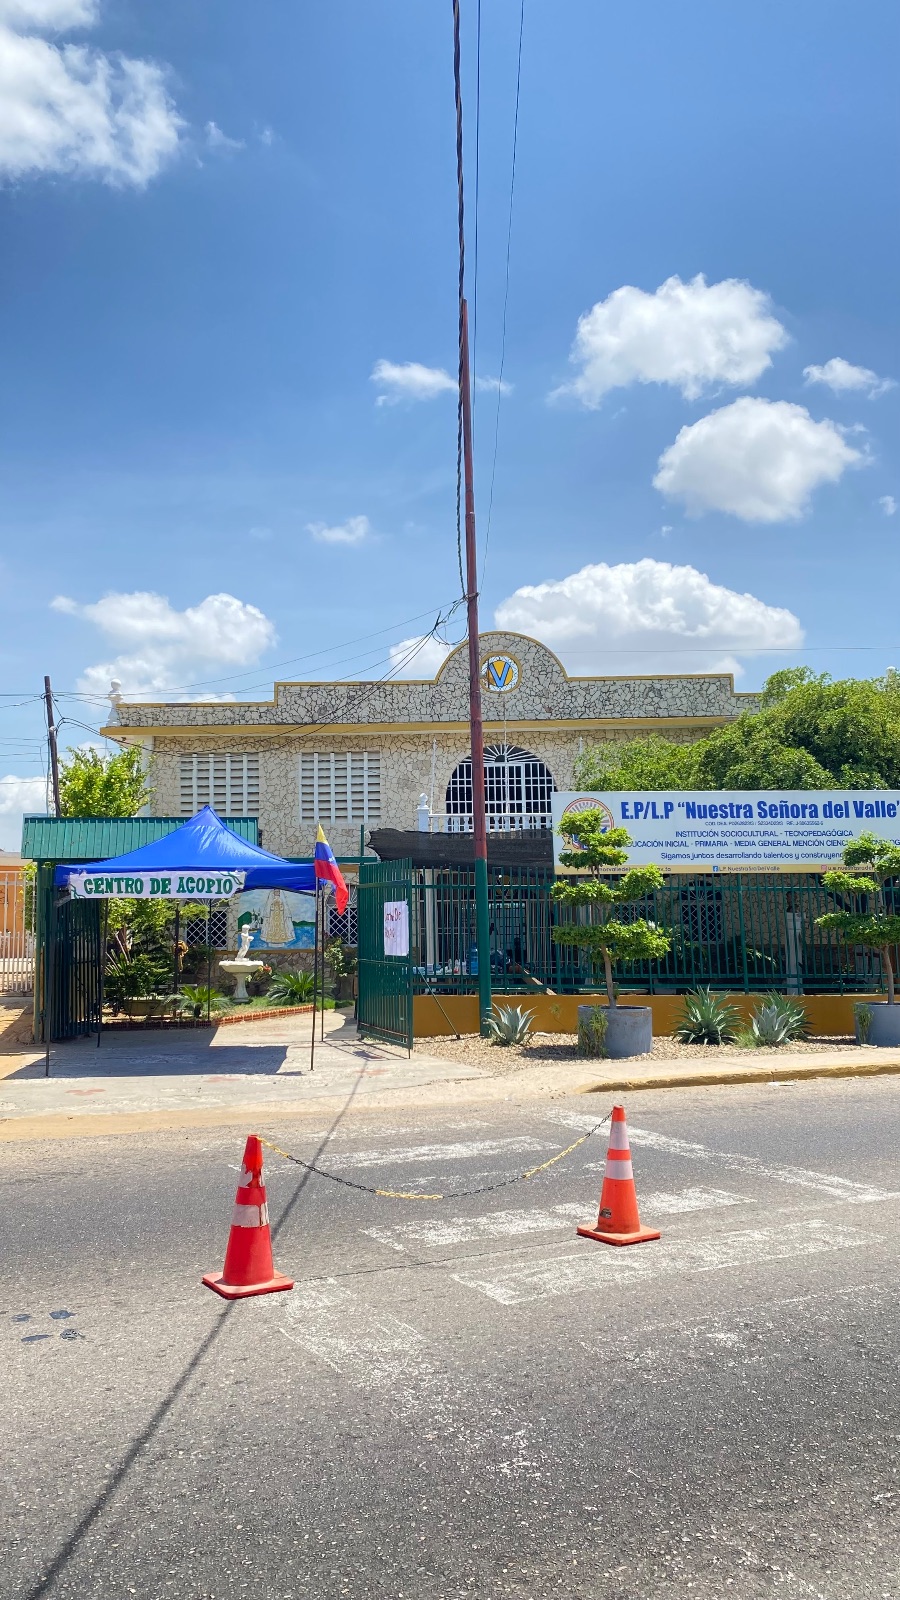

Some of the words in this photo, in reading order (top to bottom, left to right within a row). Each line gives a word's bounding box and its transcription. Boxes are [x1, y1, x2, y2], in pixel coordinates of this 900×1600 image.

[621, 801, 674, 820] E.P/L.P
[677, 801, 753, 819] “Nuestra
[757, 800, 819, 819] Señora
[823, 800, 849, 819] del
[675, 829, 719, 838] INSTITUCIÓN
[785, 829, 854, 837] TECNOPEDAGÓGICA
[664, 840, 689, 848] INICIAL
[793, 838, 825, 847] MENCIÓN
[826, 839, 848, 847] CIENC
[660, 852, 690, 860] Sigamos
[690, 852, 714, 860] juntos
[716, 851, 762, 859] desarrollando
[83, 877, 144, 895] CENTRO
[150, 877, 171, 895] DE
[176, 876, 233, 895] ACOPIO
